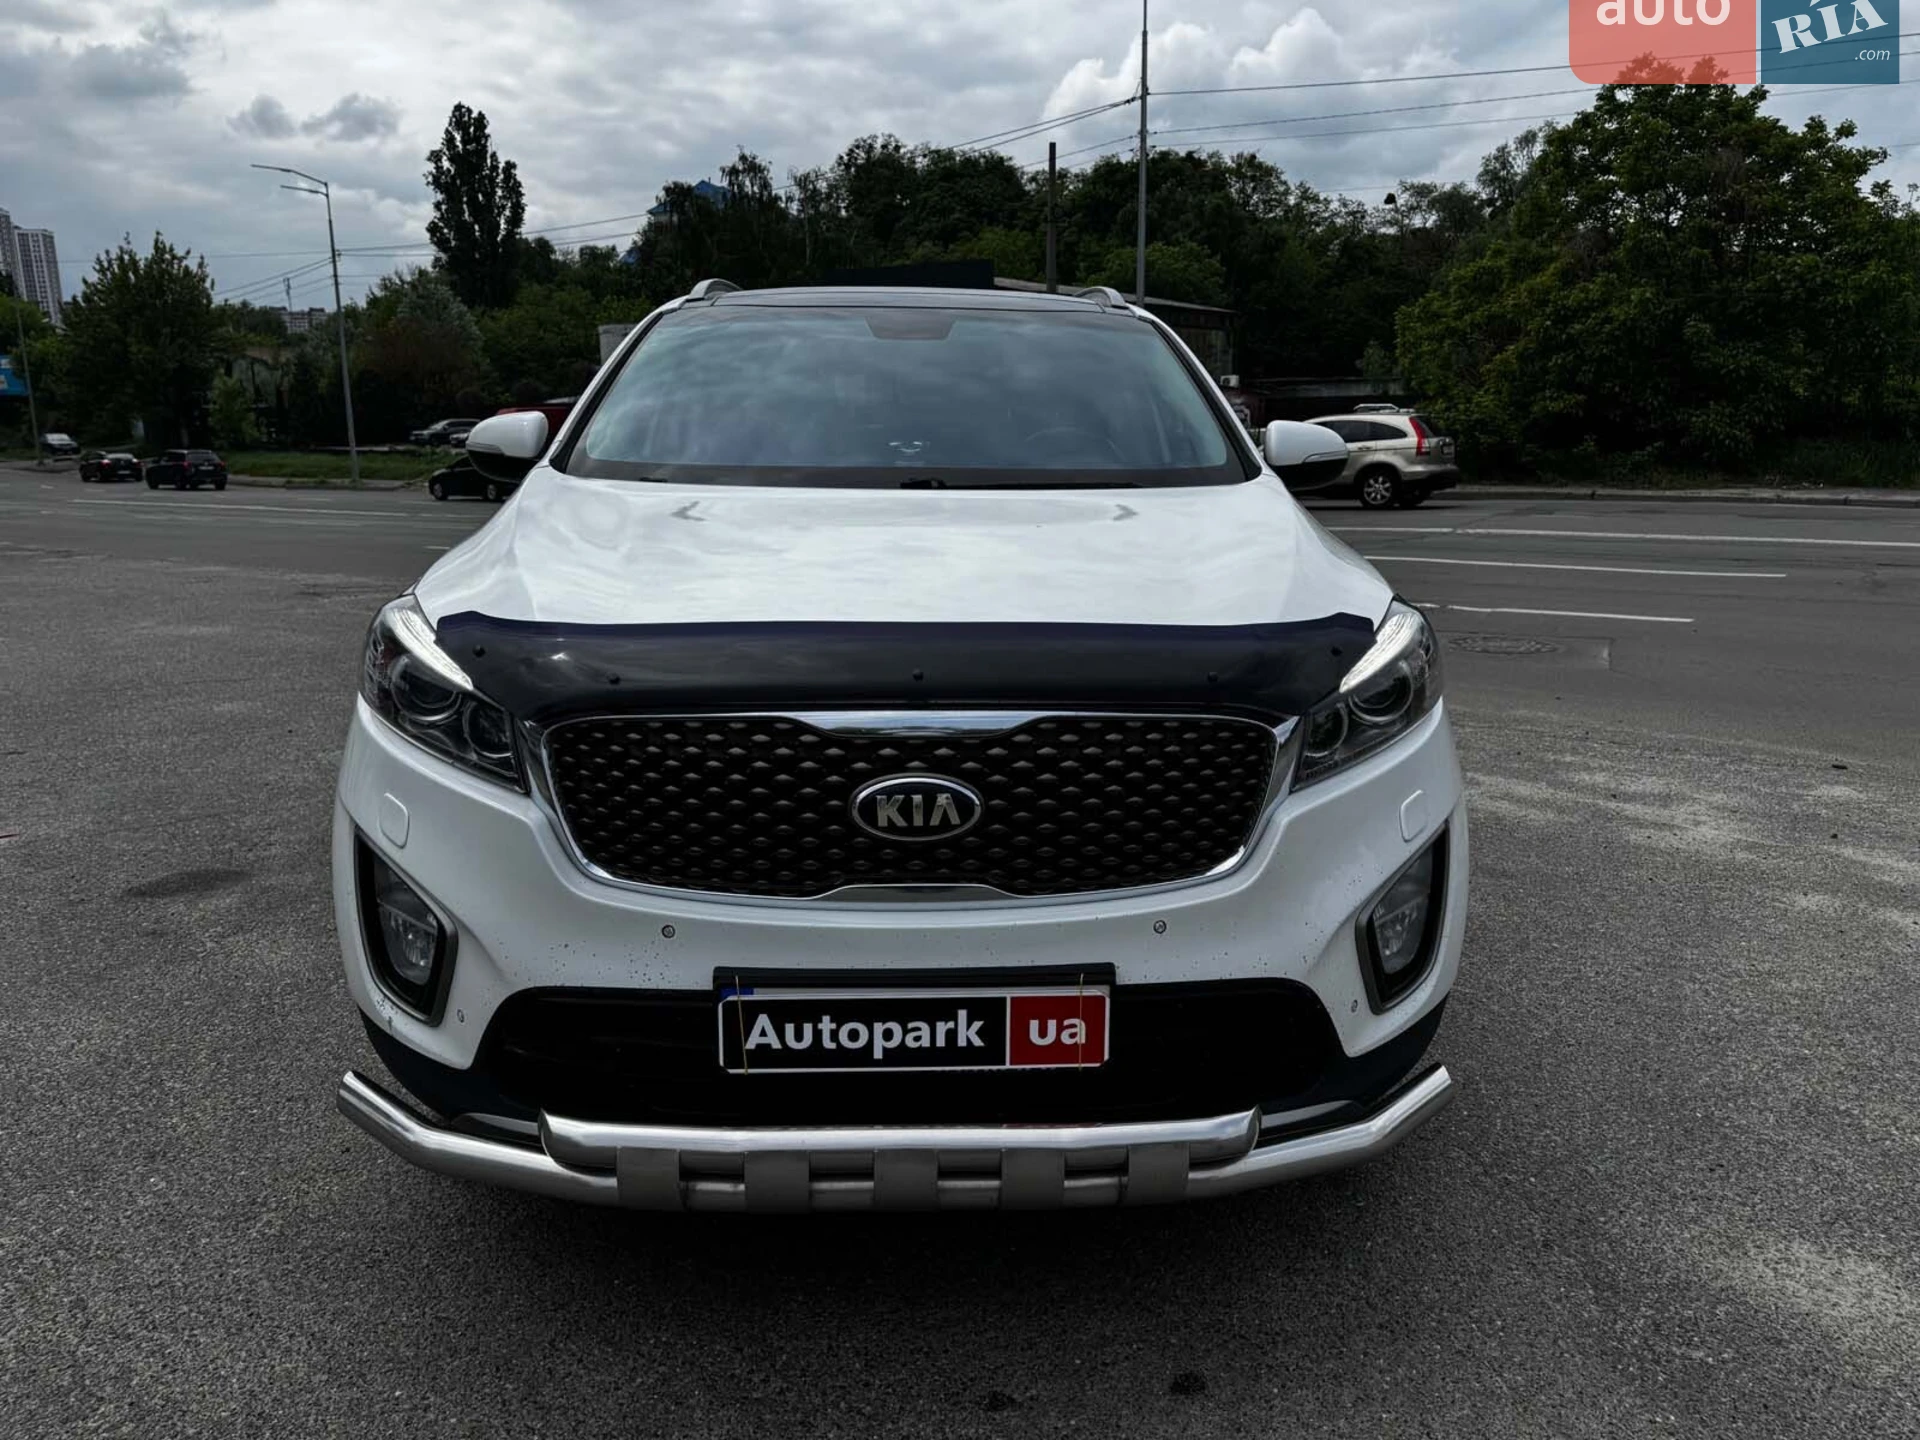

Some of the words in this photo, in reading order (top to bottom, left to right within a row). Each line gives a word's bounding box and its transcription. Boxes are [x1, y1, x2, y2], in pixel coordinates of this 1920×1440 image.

[875, 793, 961, 827] KIA
[745, 1009, 985, 1060] Autopark
[1029, 1017, 1086, 1045] ua
